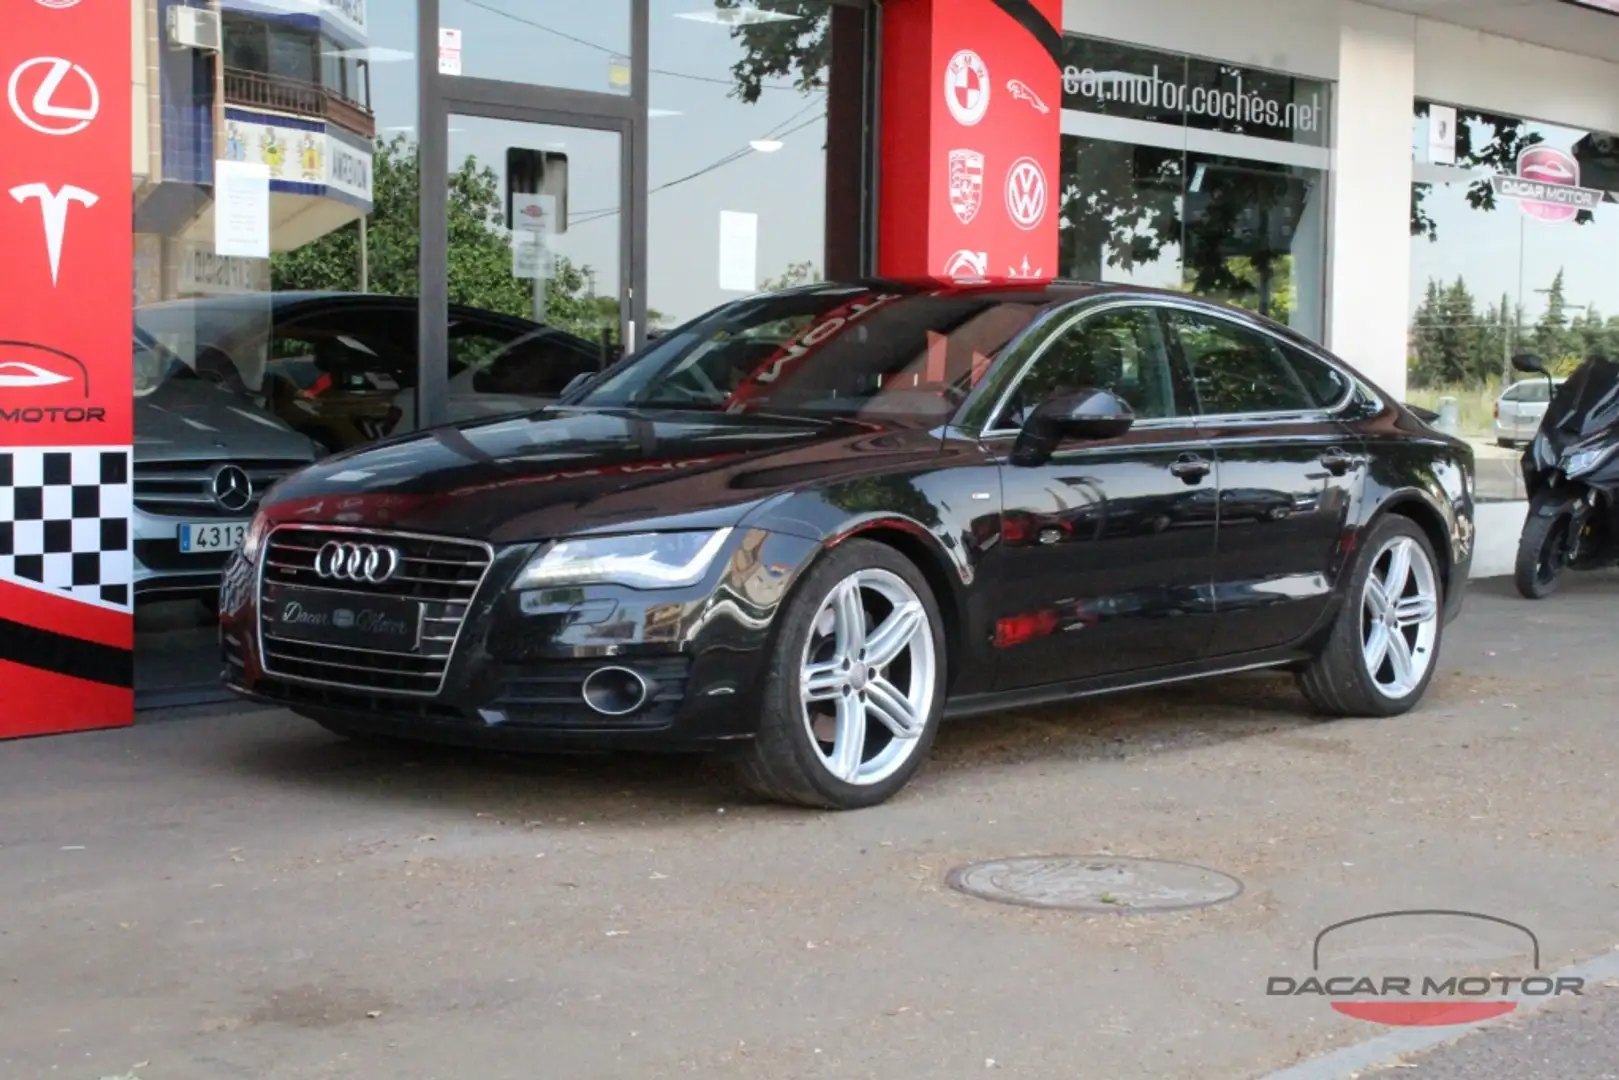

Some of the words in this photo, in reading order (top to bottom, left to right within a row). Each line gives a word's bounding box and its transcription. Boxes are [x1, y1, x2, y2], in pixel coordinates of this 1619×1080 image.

[1501, 180, 1545, 200] DACAR
[1546, 186, 1593, 205] MOTOR
[0, 407, 105, 423] MOTOR
[196, 526, 244, 547] 4313
